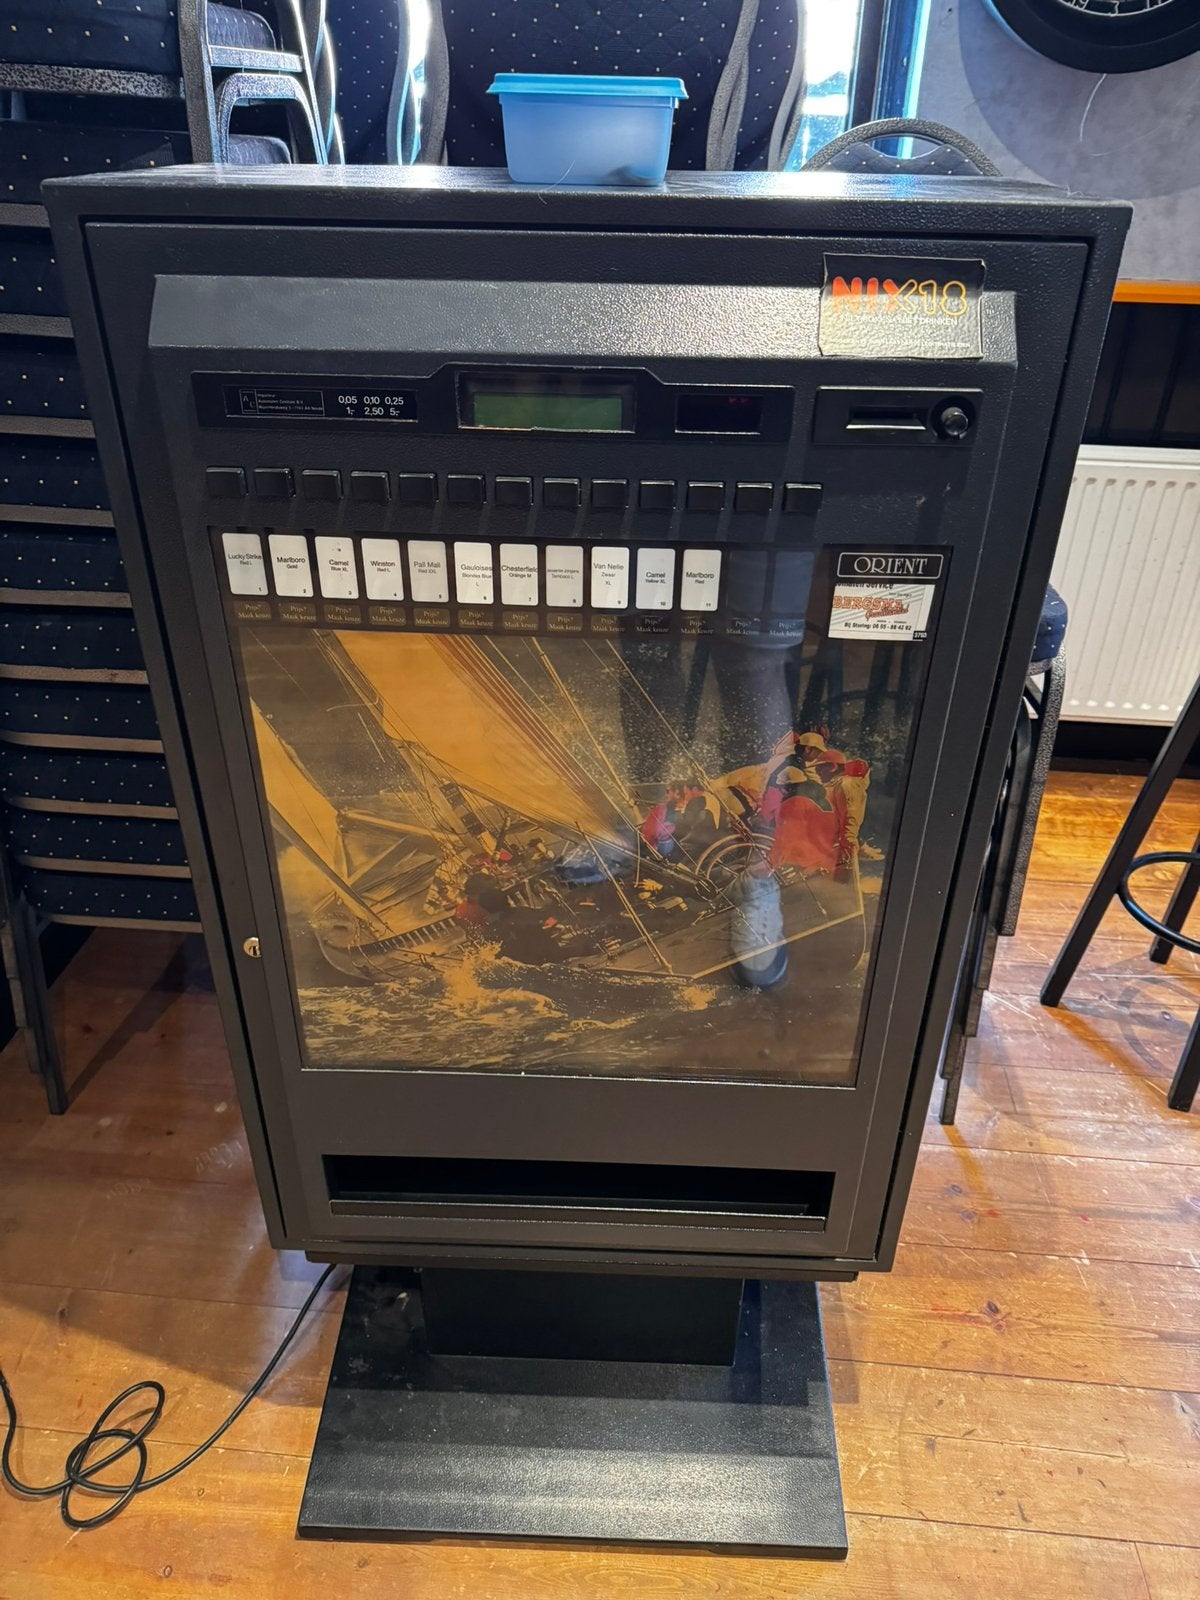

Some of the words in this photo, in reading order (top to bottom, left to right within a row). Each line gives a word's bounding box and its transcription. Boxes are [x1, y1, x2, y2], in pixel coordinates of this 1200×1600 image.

[920, 318, 958, 326] DRINKEN
[338, 396, 358, 405] 0,05
[363, 396, 380, 405] 0,10
[384, 396, 404, 405] 0,25
[364, 407, 384, 416] 2,50
[608, 563, 624, 571] Nelle
[854, 556, 928, 574] ORIENT
[686, 571, 714, 579] Marlboro
[832, 595, 904, 610] BERGSMA
